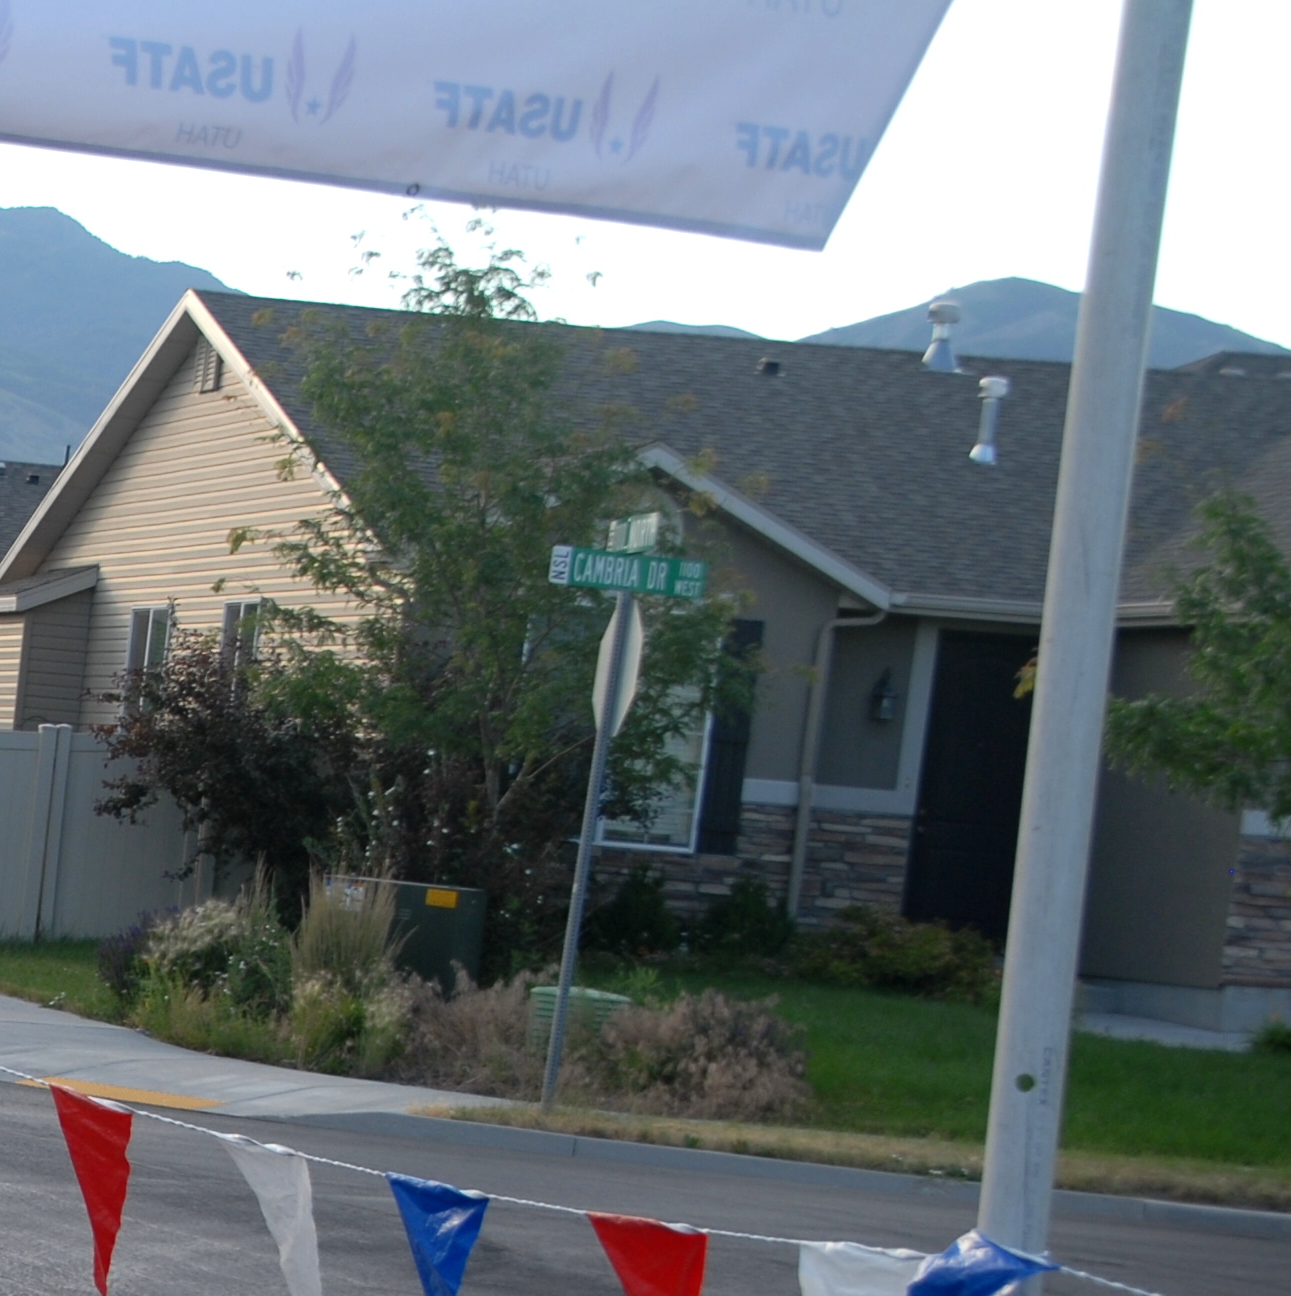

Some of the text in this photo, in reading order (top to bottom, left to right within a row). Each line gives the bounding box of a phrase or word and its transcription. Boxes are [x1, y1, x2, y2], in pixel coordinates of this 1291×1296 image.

[573, 552, 668, 591] CAMBRIA DR
[678, 562, 701, 578] 1100
[674, 580, 701, 597] WEST
